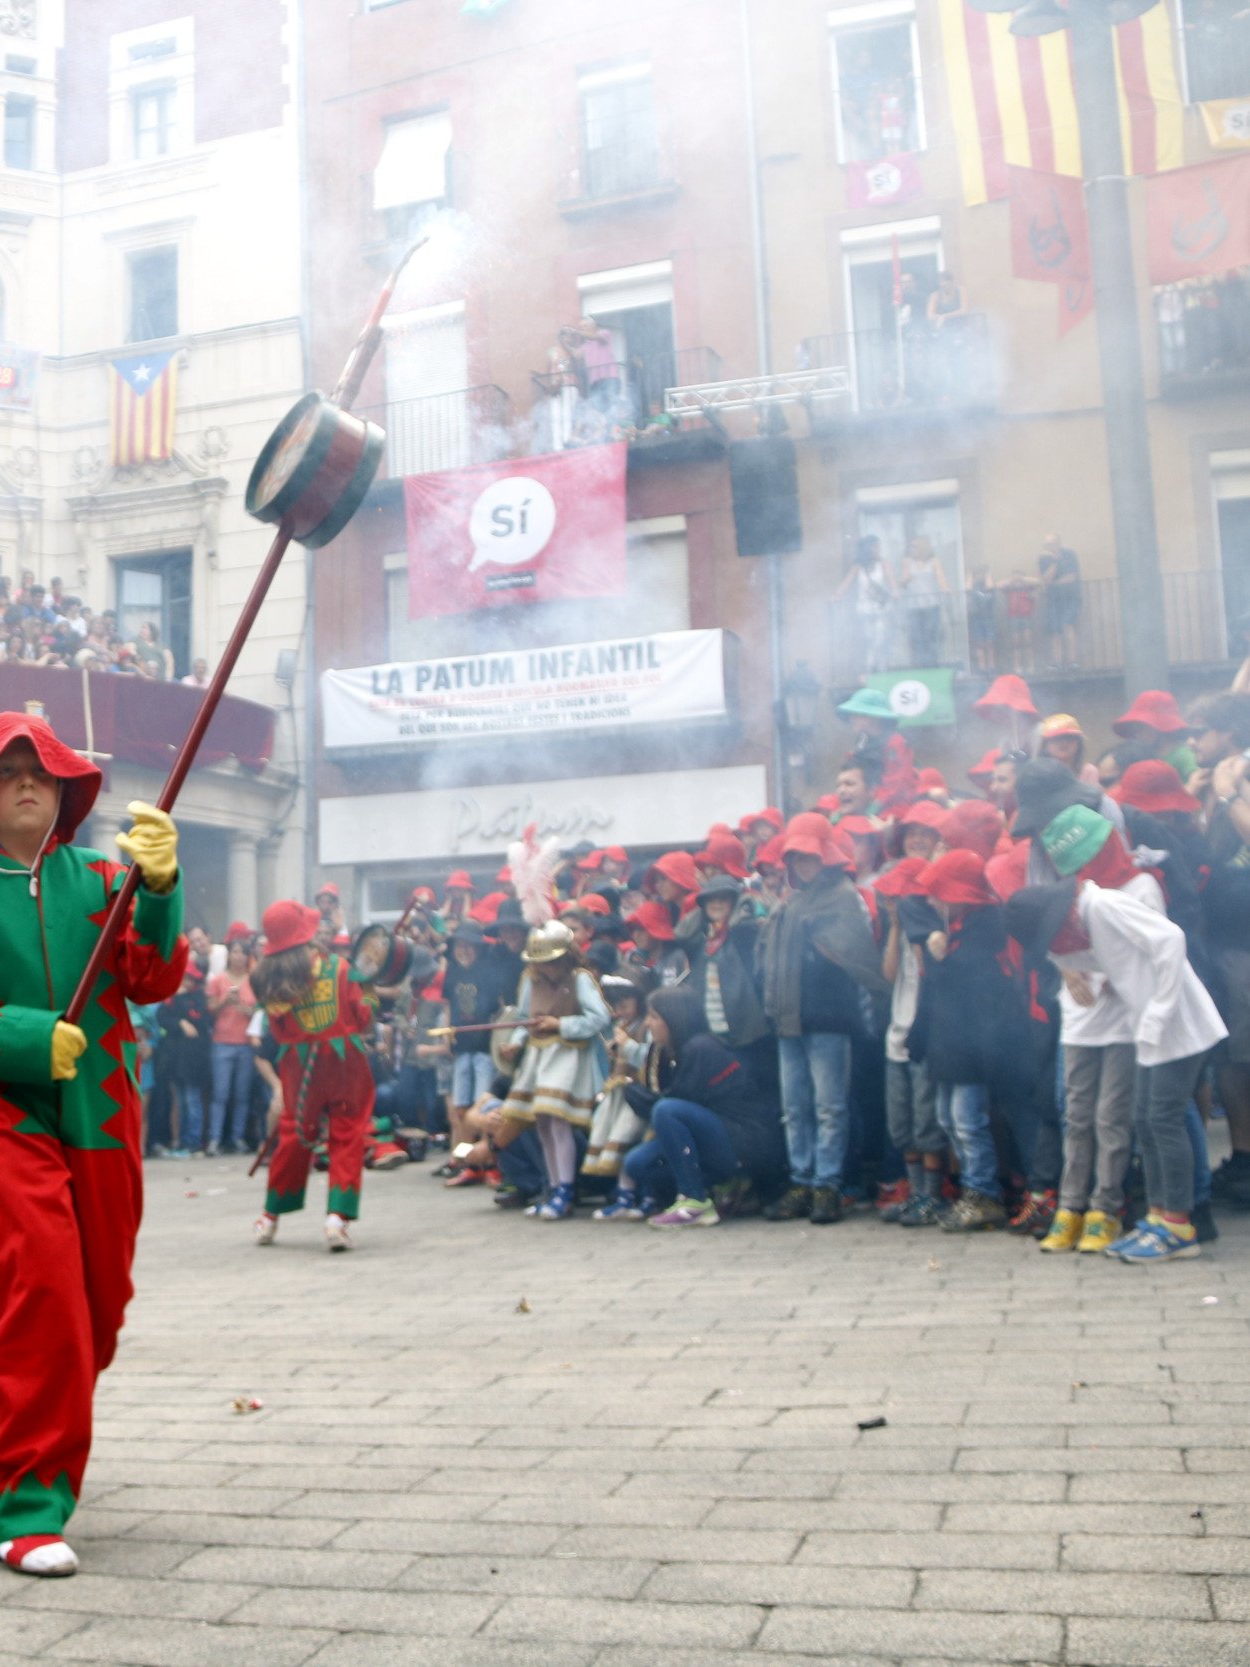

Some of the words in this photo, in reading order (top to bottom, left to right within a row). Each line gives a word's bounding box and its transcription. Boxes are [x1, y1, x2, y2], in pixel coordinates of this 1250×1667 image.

[490, 497, 533, 538] Sí
[371, 668, 403, 695] LA
[415, 657, 515, 692] PATUM
[528, 641, 661, 682] INFANTIL
